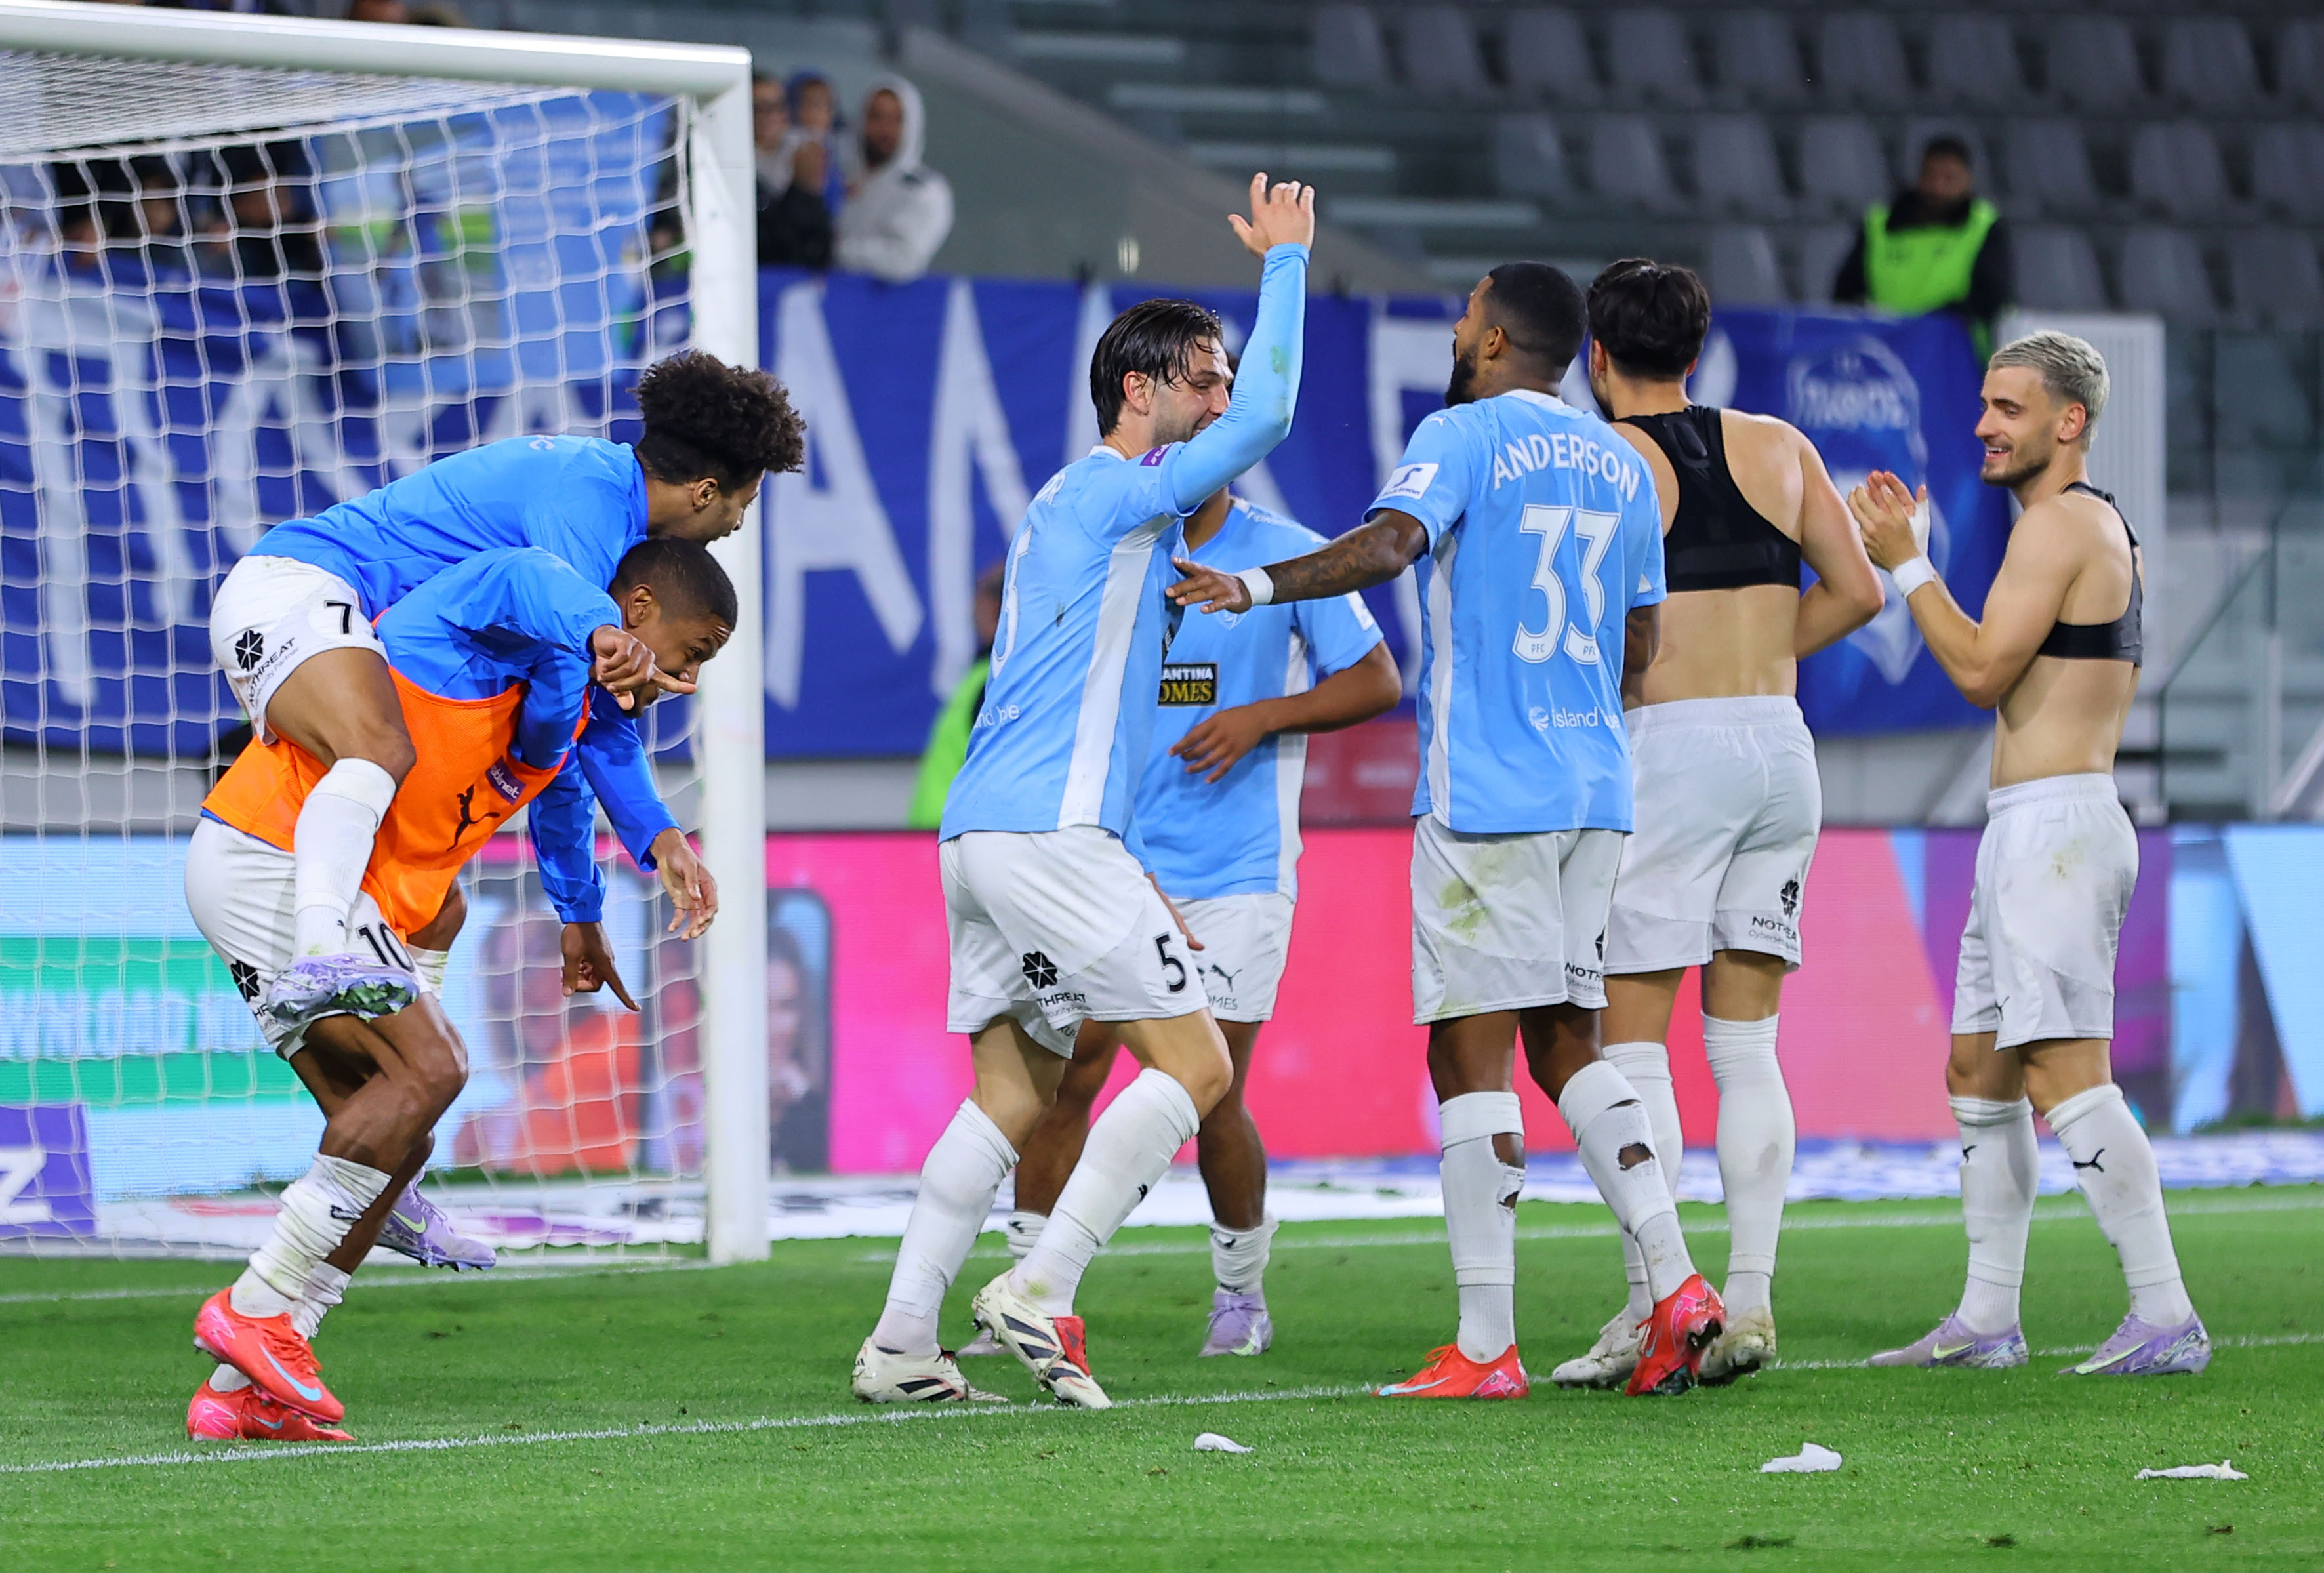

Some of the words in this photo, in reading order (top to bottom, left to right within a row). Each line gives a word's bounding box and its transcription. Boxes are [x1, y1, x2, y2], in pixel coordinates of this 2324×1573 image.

[1493, 433, 1639, 503] ANDERSON
[1511, 503, 1622, 665] 33
[324, 600, 354, 636] 7
[1531, 643, 1545, 654] PFC
[1162, 668, 1213, 681] ANTINA
[1160, 682, 1212, 702] OMES
[1551, 706, 1599, 729] island
[356, 921, 415, 973] 10
[1153, 931, 1187, 995] 5
[1036, 992, 1086, 1009] THREAT
[1207, 994, 1238, 1011] MES
